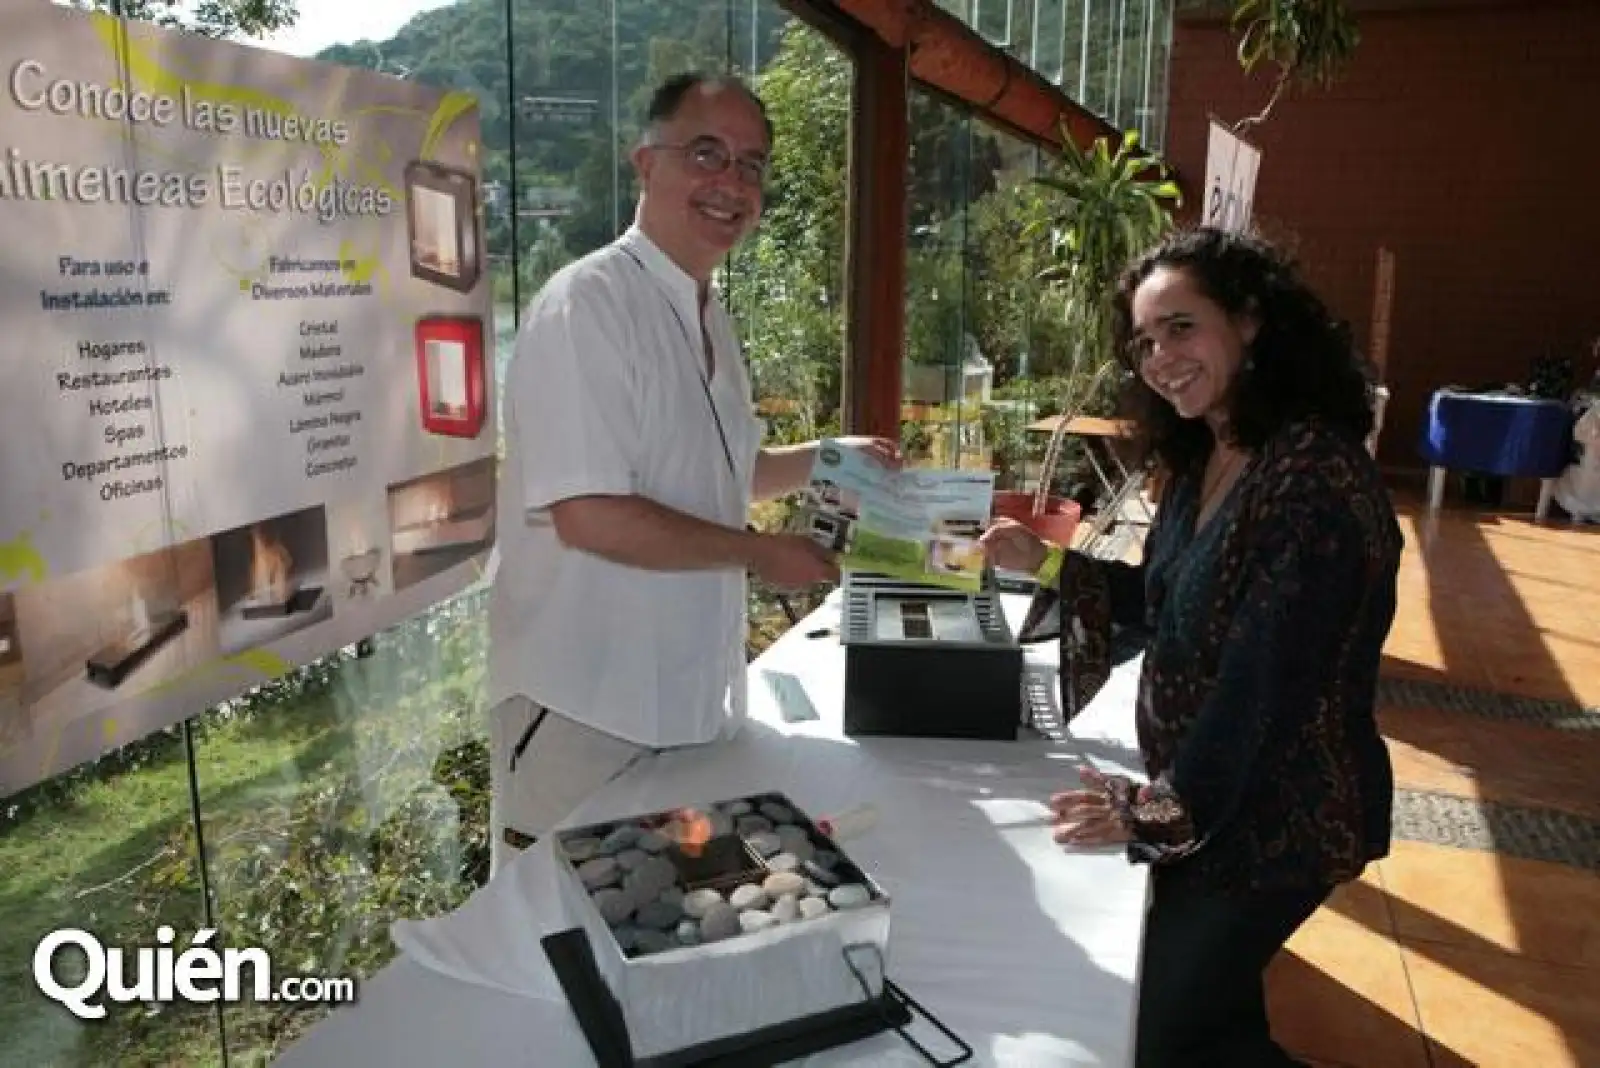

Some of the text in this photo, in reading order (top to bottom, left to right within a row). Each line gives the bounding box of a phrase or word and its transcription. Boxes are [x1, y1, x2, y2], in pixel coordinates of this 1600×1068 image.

[9, 58, 350, 145] Conoce las nuevas
[0, 146, 392, 223] imeneas Ecológicas
[59, 256, 101, 276] Para
[104, 260, 136, 276] uso
[40, 287, 143, 311] Instalación
[252, 281, 372, 301] Diversos Materiales
[77, 341, 146, 360] Hogares
[56, 366, 172, 390] Restaurantes
[89, 395, 153, 417] Hoteles
[104, 424, 145, 447] Spas
[61, 445, 188, 482] Departamentos
[100, 475, 164, 501] Oficinas
